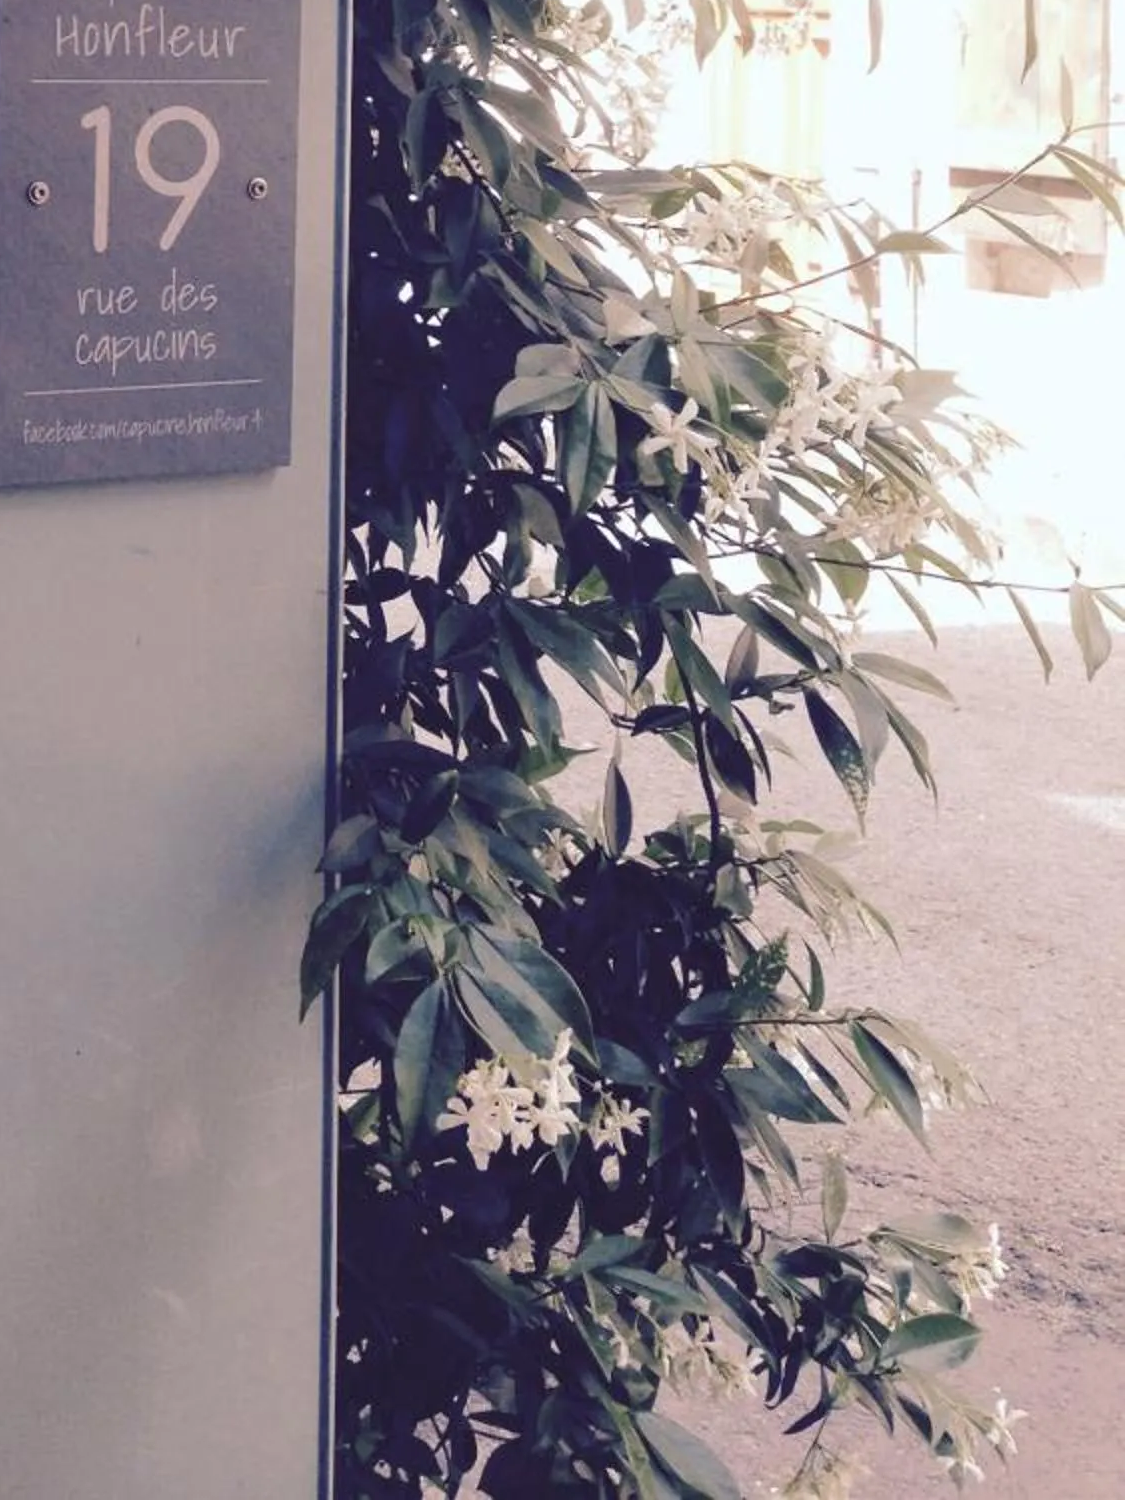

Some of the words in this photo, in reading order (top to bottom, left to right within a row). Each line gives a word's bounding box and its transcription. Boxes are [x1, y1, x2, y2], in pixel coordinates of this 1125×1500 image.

[56, 3, 246, 58] Honfleur
[80, 105, 221, 254] 19
[77, 285, 138, 315] rue
[161, 266, 218, 315] des
[75, 329, 217, 377] capucins
